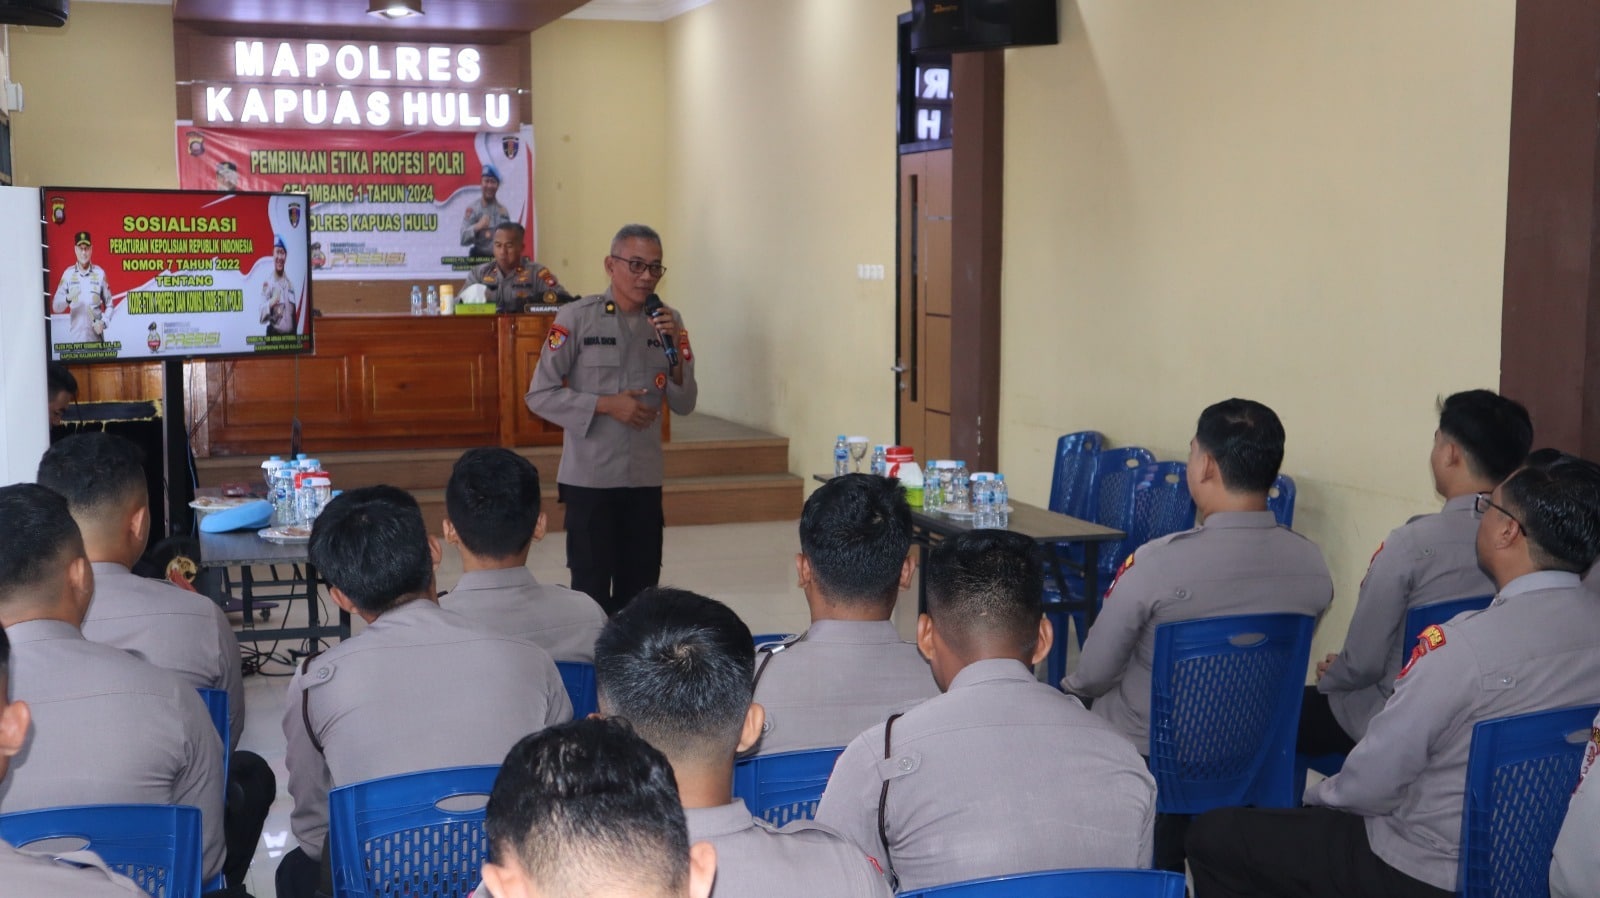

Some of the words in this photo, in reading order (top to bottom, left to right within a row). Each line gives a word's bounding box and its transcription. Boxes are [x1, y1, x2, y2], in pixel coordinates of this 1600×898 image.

[234, 41, 481, 82] MAPOLRES
[205, 87, 391, 126] KAPUAS
[403, 92, 510, 128] HULU
[251, 150, 327, 174] PEMBINAAN
[331, 151, 369, 174] ETIKA
[372, 151, 424, 174] PROFESI
[428, 151, 465, 174] POLRI
[357, 184, 363, 202] 1
[367, 183, 406, 203] TAHUN
[407, 184, 434, 203] 2024
[123, 216, 237, 233] SOSIALISASI
[309, 213, 348, 232] OLRES
[351, 214, 400, 232] KAPUAS
[404, 214, 438, 231] HULU
[110, 238, 149, 254] PERATURAN
[150, 238, 188, 254] KEPOLISIAN
[188, 238, 219, 254] REPUBLIK
[220, 239, 253, 254] INDONESIA
[122, 259, 164, 271] NOMOR
[166, 260, 173, 270] 7
[176, 259, 213, 271] TAHUN
[215, 259, 240, 271] 2022
[156, 275, 213, 287] TENTANG
